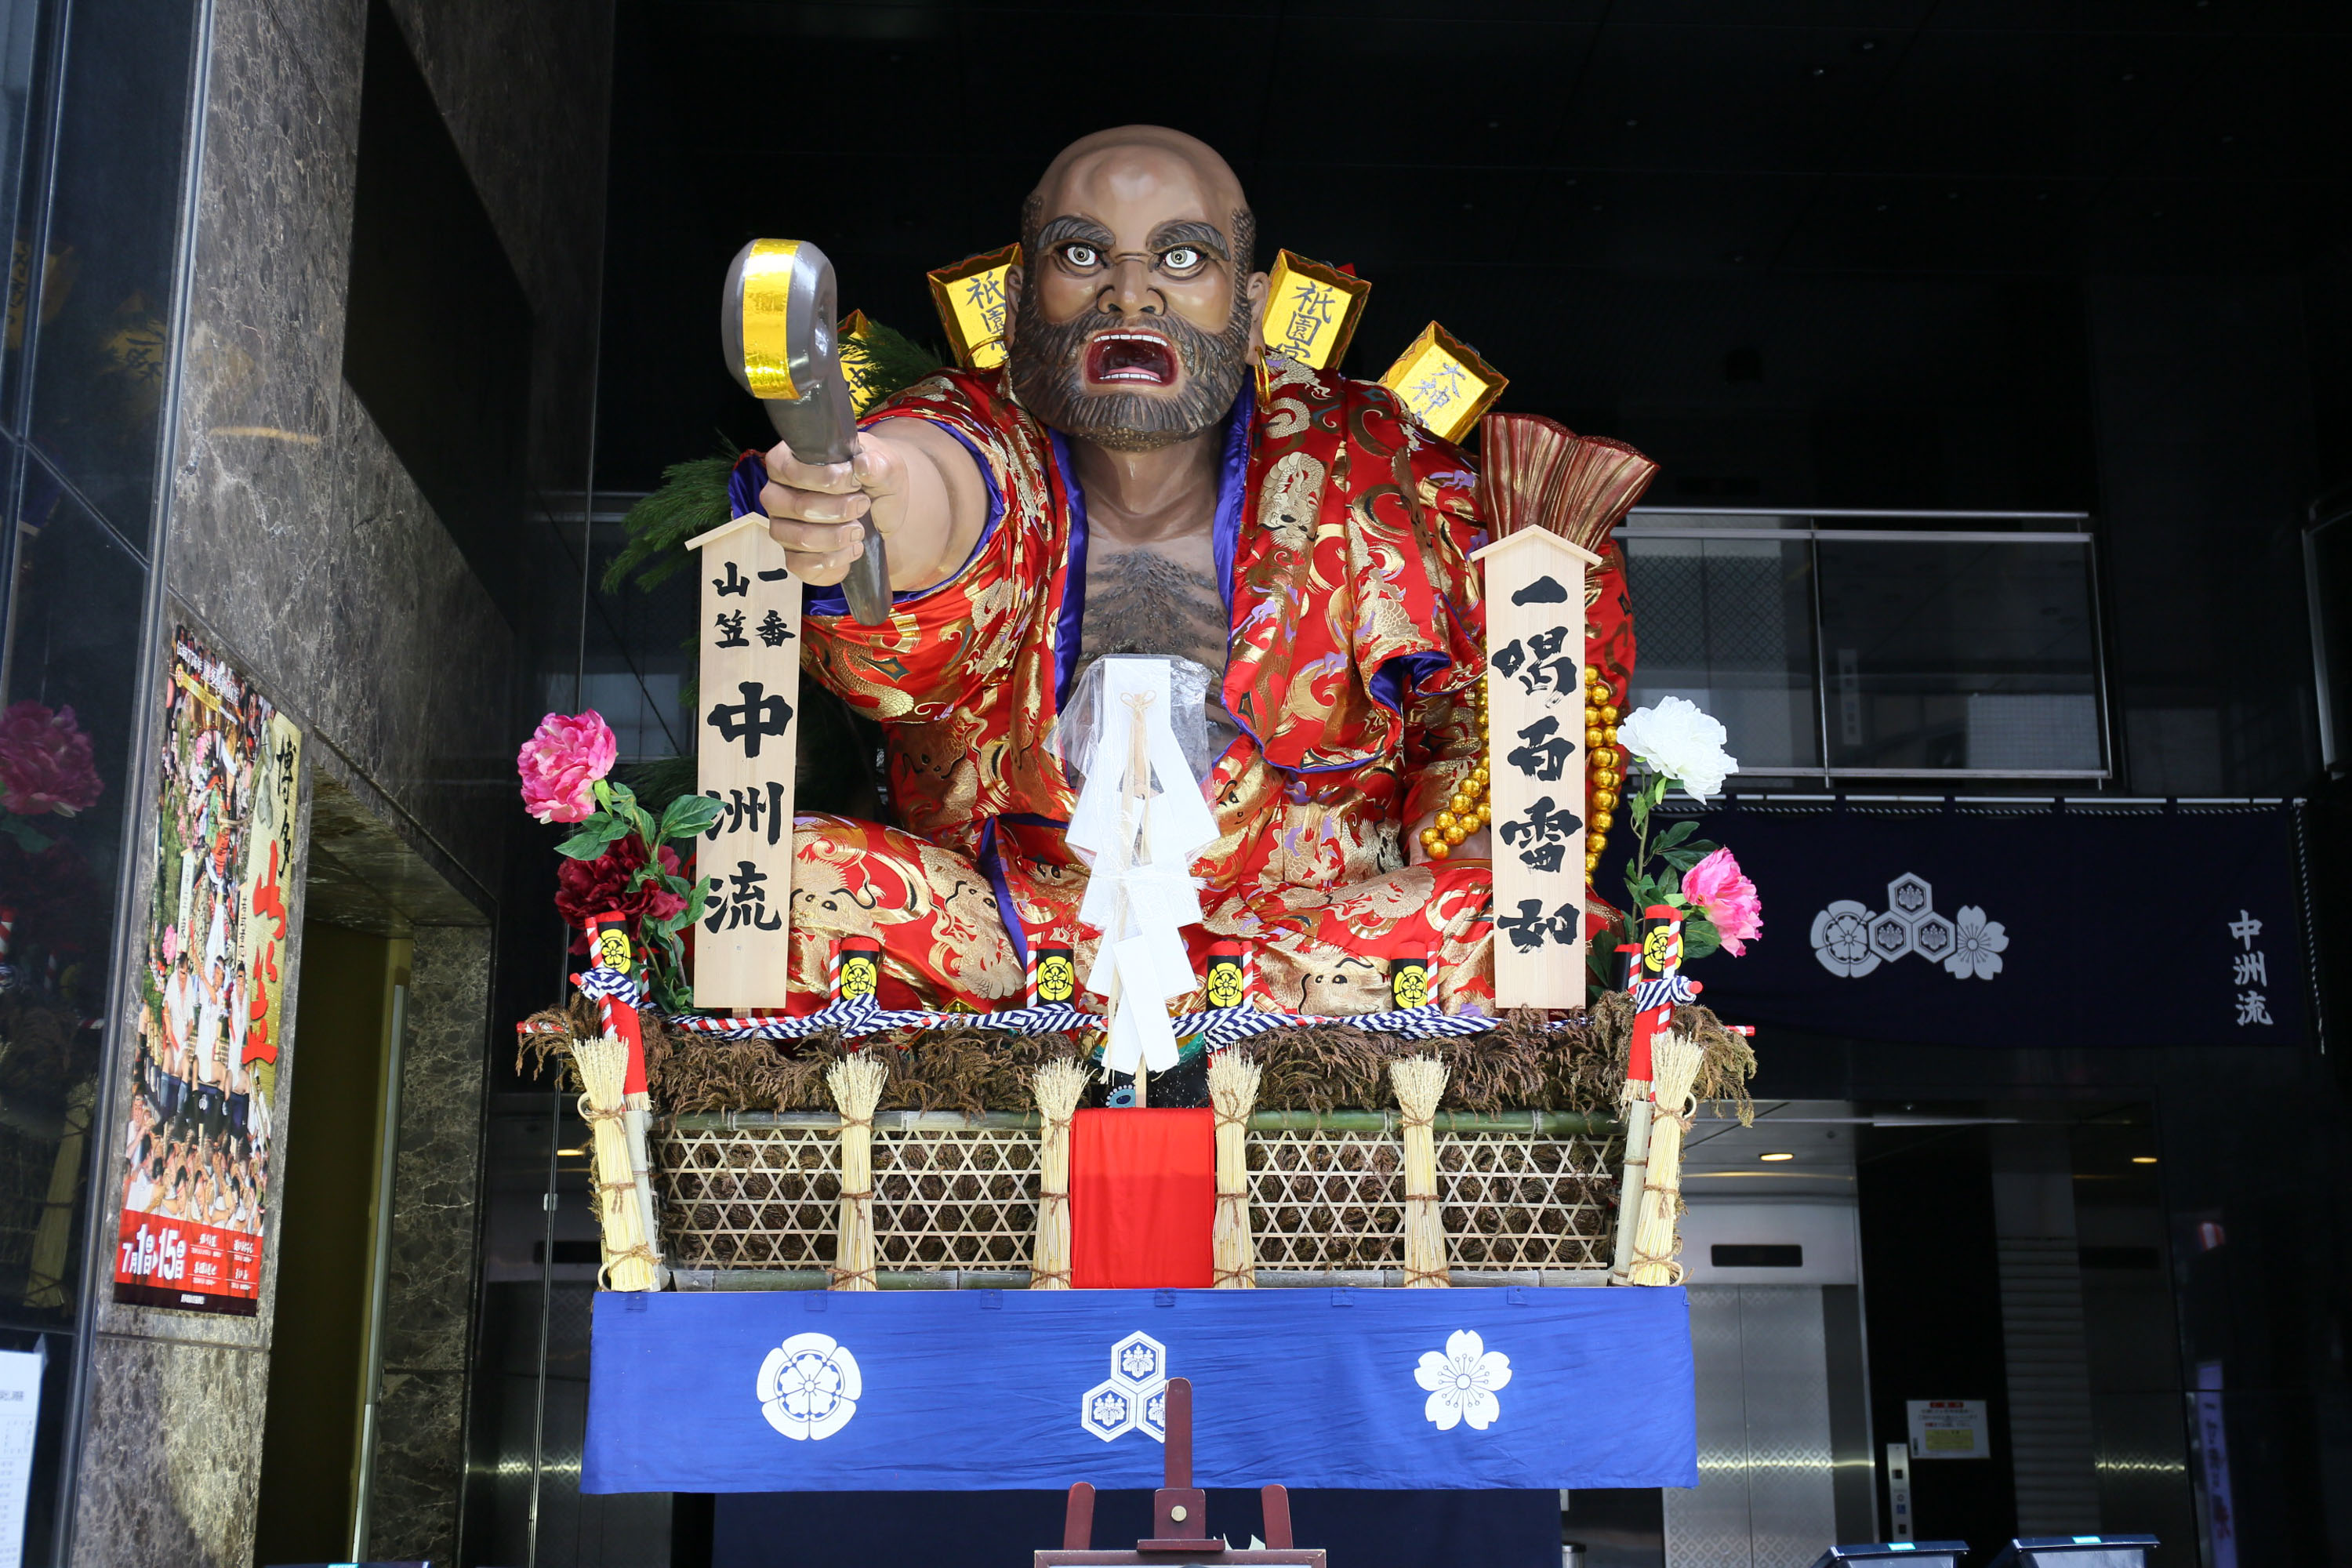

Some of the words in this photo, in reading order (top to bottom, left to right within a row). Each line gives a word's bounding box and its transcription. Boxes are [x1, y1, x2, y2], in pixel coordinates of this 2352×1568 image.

[275, 734, 297, 878] 博多
[704, 681, 794, 935] 中洲流
[2227, 909, 2274, 1026] 中洲流
